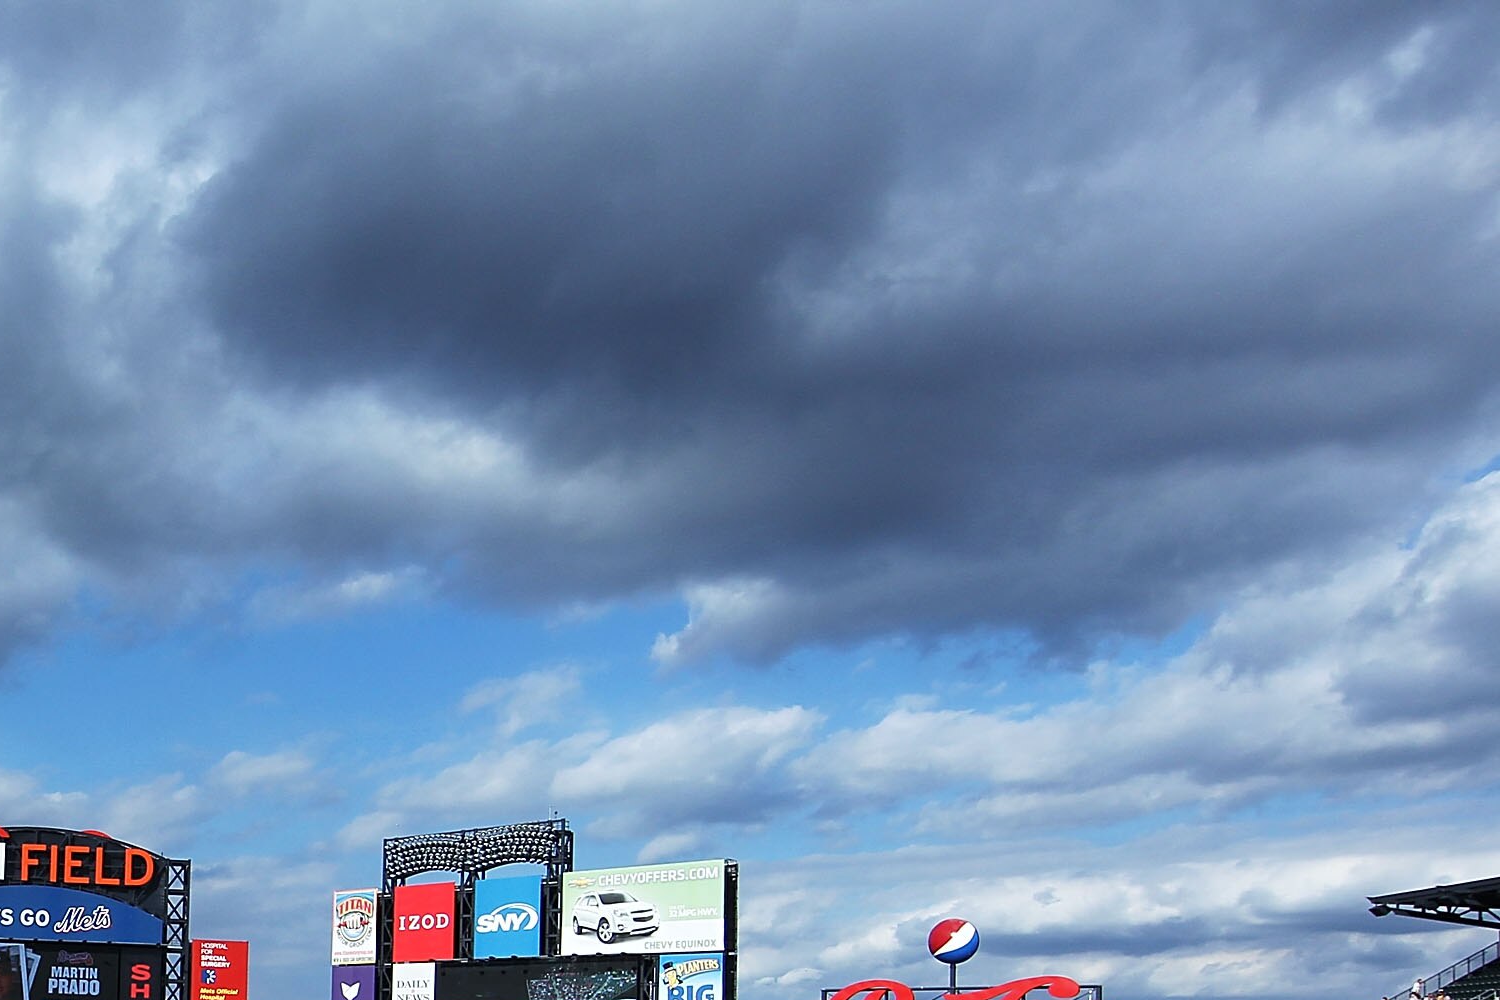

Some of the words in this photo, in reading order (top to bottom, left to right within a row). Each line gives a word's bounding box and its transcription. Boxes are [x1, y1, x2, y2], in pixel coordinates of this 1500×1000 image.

[21, 844, 154, 886] FIELD
[597, 867, 718, 887] CHEVYOFFERS.COM
[339, 899, 370, 914] TITAN
[20, 909, 49, 927] GO
[54, 905, 111, 933] Mets
[399, 914, 449, 930] IZOD
[475, 912, 529, 933] SNY
[644, 939, 672, 949] CHEVY
[675, 938, 715, 948] EQUINOX
[51, 966, 98, 980] MARTIN
[678, 960, 719, 977] PLANTERS
[48, 978, 100, 996] PRADO
[397, 980, 430, 989] DAILY
